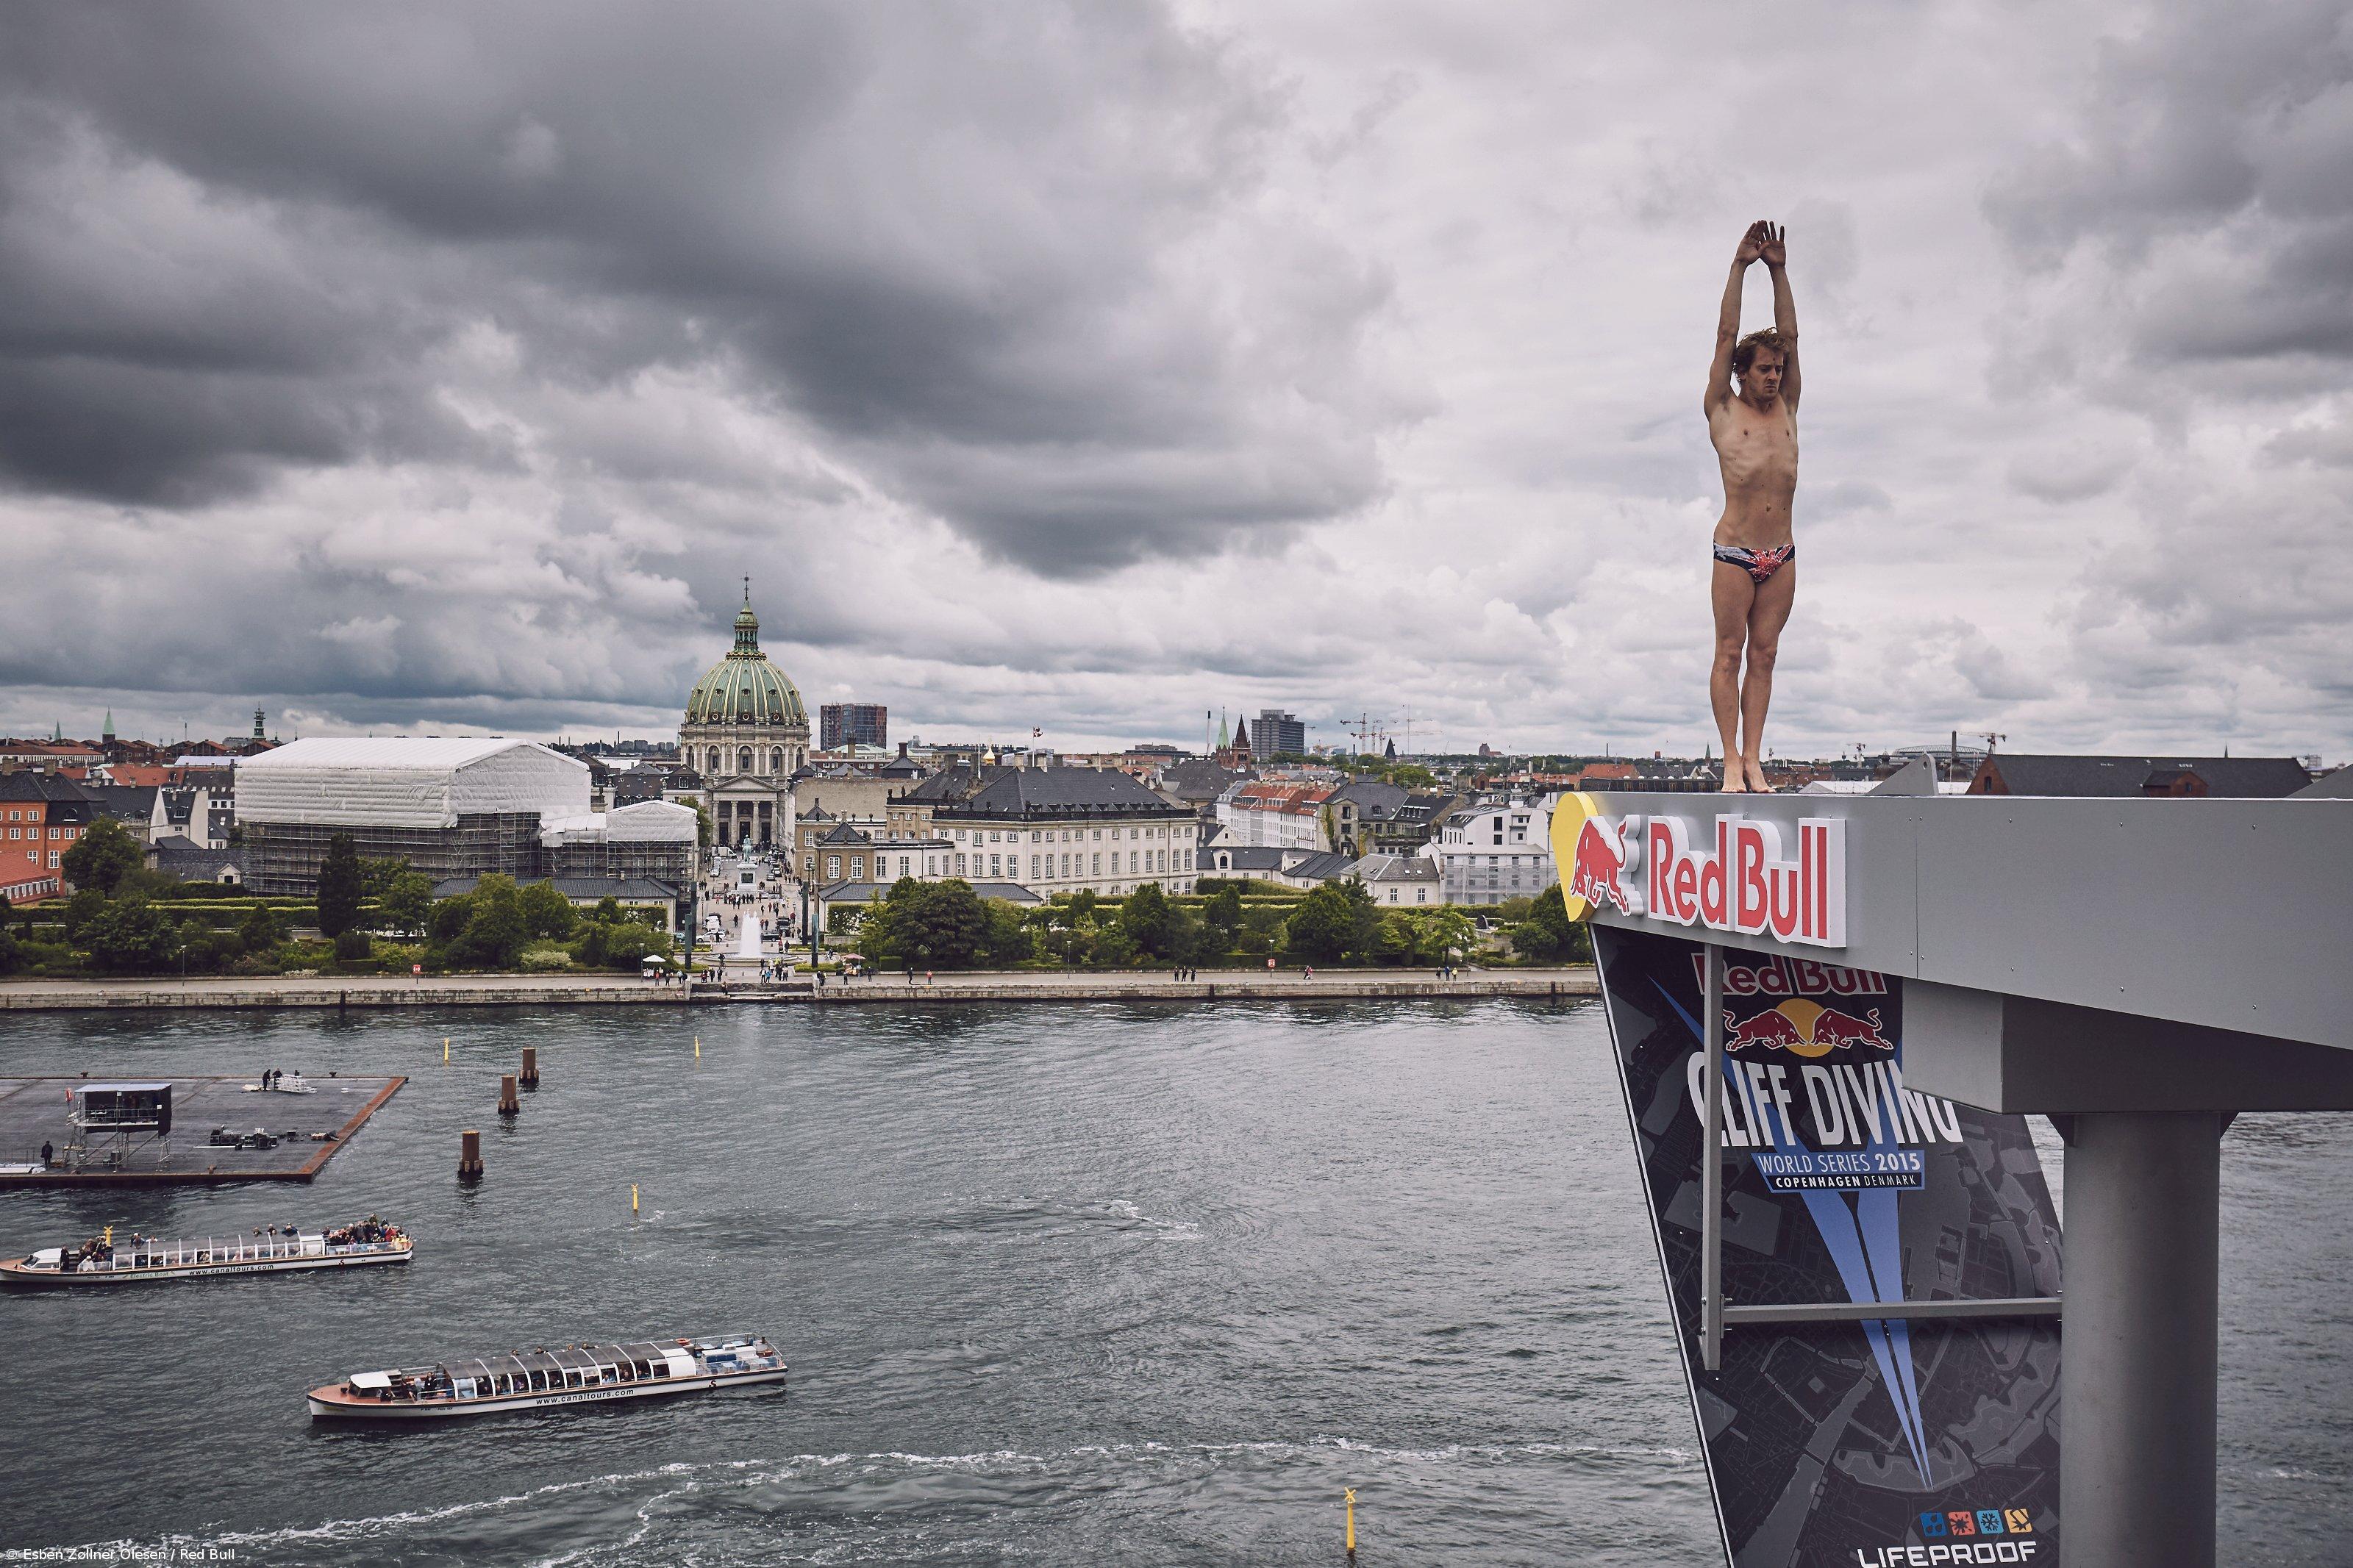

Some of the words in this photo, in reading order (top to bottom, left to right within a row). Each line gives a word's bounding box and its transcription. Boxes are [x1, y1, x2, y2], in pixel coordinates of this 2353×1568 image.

[1650, 821, 1727, 925] Red
[1738, 826, 1827, 939] Bull
[1758, 1154, 1813, 1173] WORLD
[1818, 1153, 1871, 1173] SERIES
[1875, 1153, 1921, 1171] 2015
[1776, 1175, 1861, 1188] COPENHAGEN
[1864, 1175, 1916, 1186] DENMARK
[189, 1264, 274, 1275] www.canaltours.com
[536, 1389, 634, 1405] www.canaltours.com
[1857, 1541, 2037, 1568] LIFEPROOF
